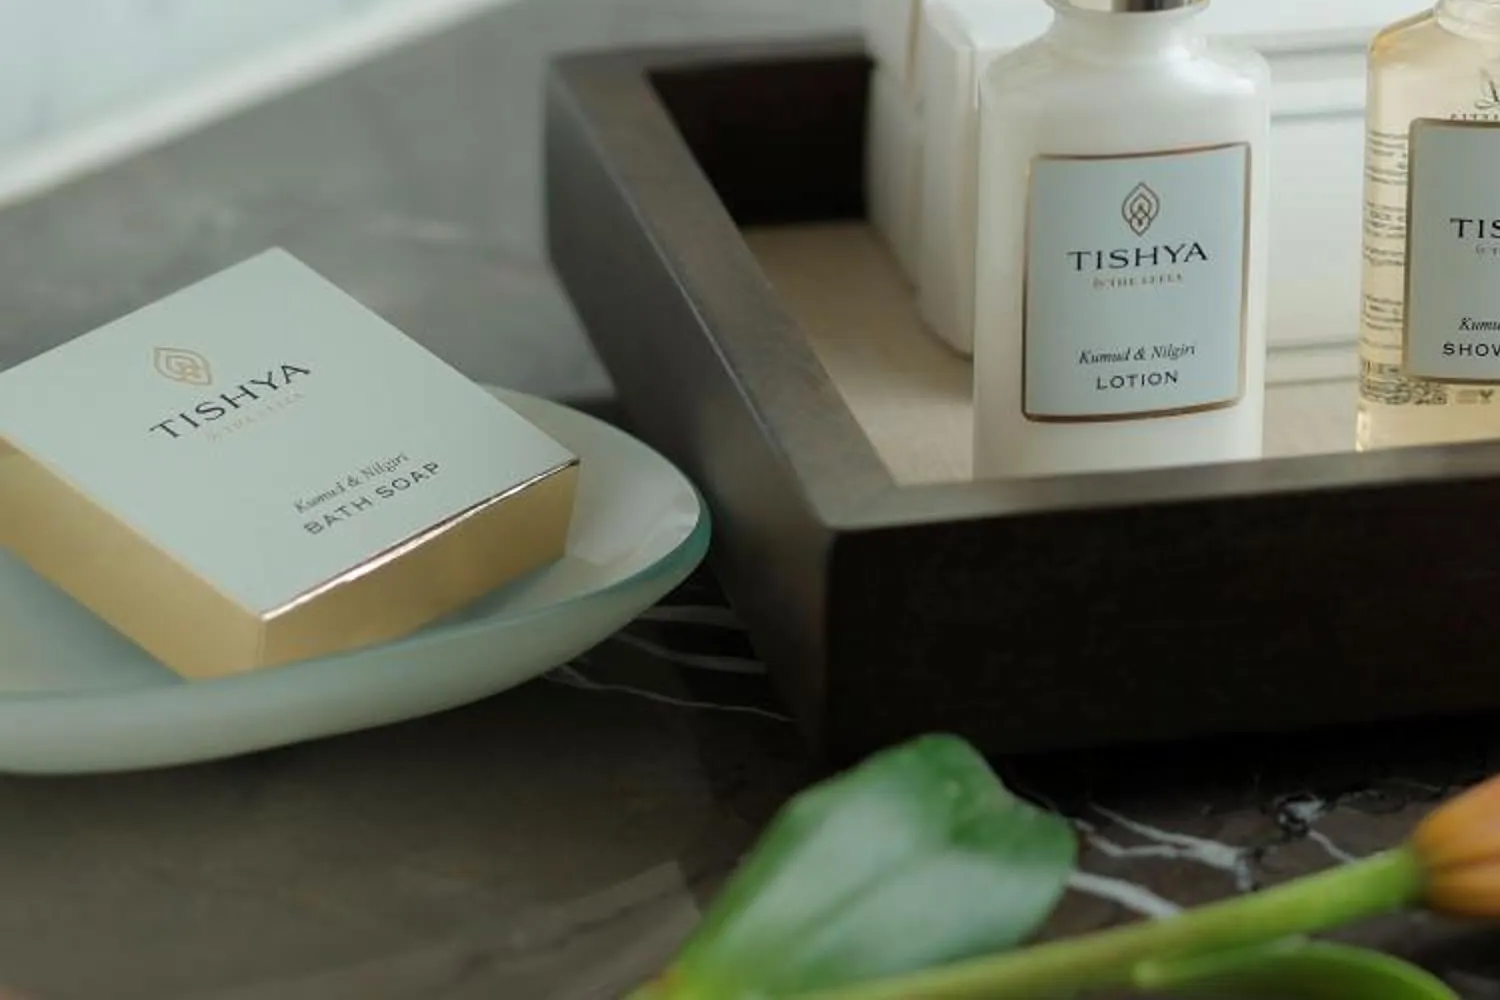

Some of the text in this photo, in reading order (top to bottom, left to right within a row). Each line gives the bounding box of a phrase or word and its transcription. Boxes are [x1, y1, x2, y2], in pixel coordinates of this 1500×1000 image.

[1066, 242, 1208, 271] TISHYA
[1079, 343, 1196, 365] Kumud & Nilgiri
[149, 363, 311, 439] TISHYA
[1096, 370, 1179, 391] LOTION
[294, 452, 411, 514] Kumud & Nilgiri
[303, 460, 441, 535] BATH SOAP
